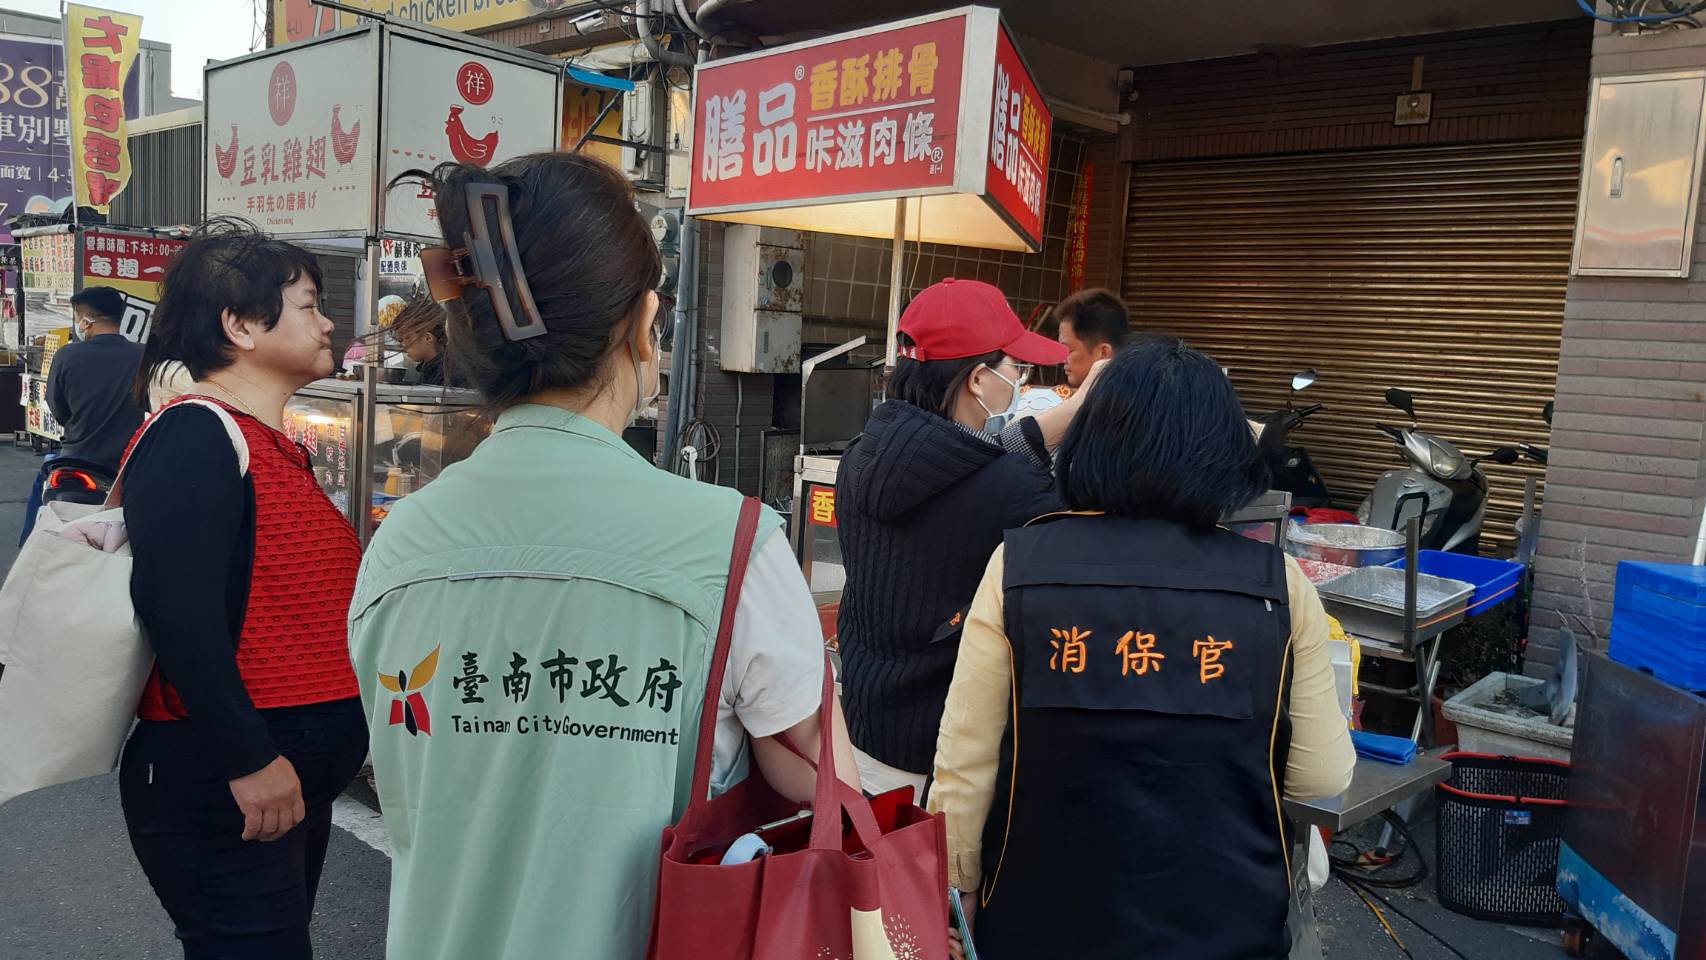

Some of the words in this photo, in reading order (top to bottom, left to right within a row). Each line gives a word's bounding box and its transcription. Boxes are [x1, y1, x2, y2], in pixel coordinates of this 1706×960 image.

[274, 74, 291, 112] 祥
[464, 70, 486, 96] 祥
[810, 42, 938, 111] 香酥排骨
[702, 82, 798, 184] 膳品
[240, 135, 326, 187] 豆乳雞翅
[812, 490, 835, 523] 香
[1050, 625, 1233, 684] 消保官
[453, 648, 683, 714] 臺南市政府
[451, 715, 511, 734] Tainan
